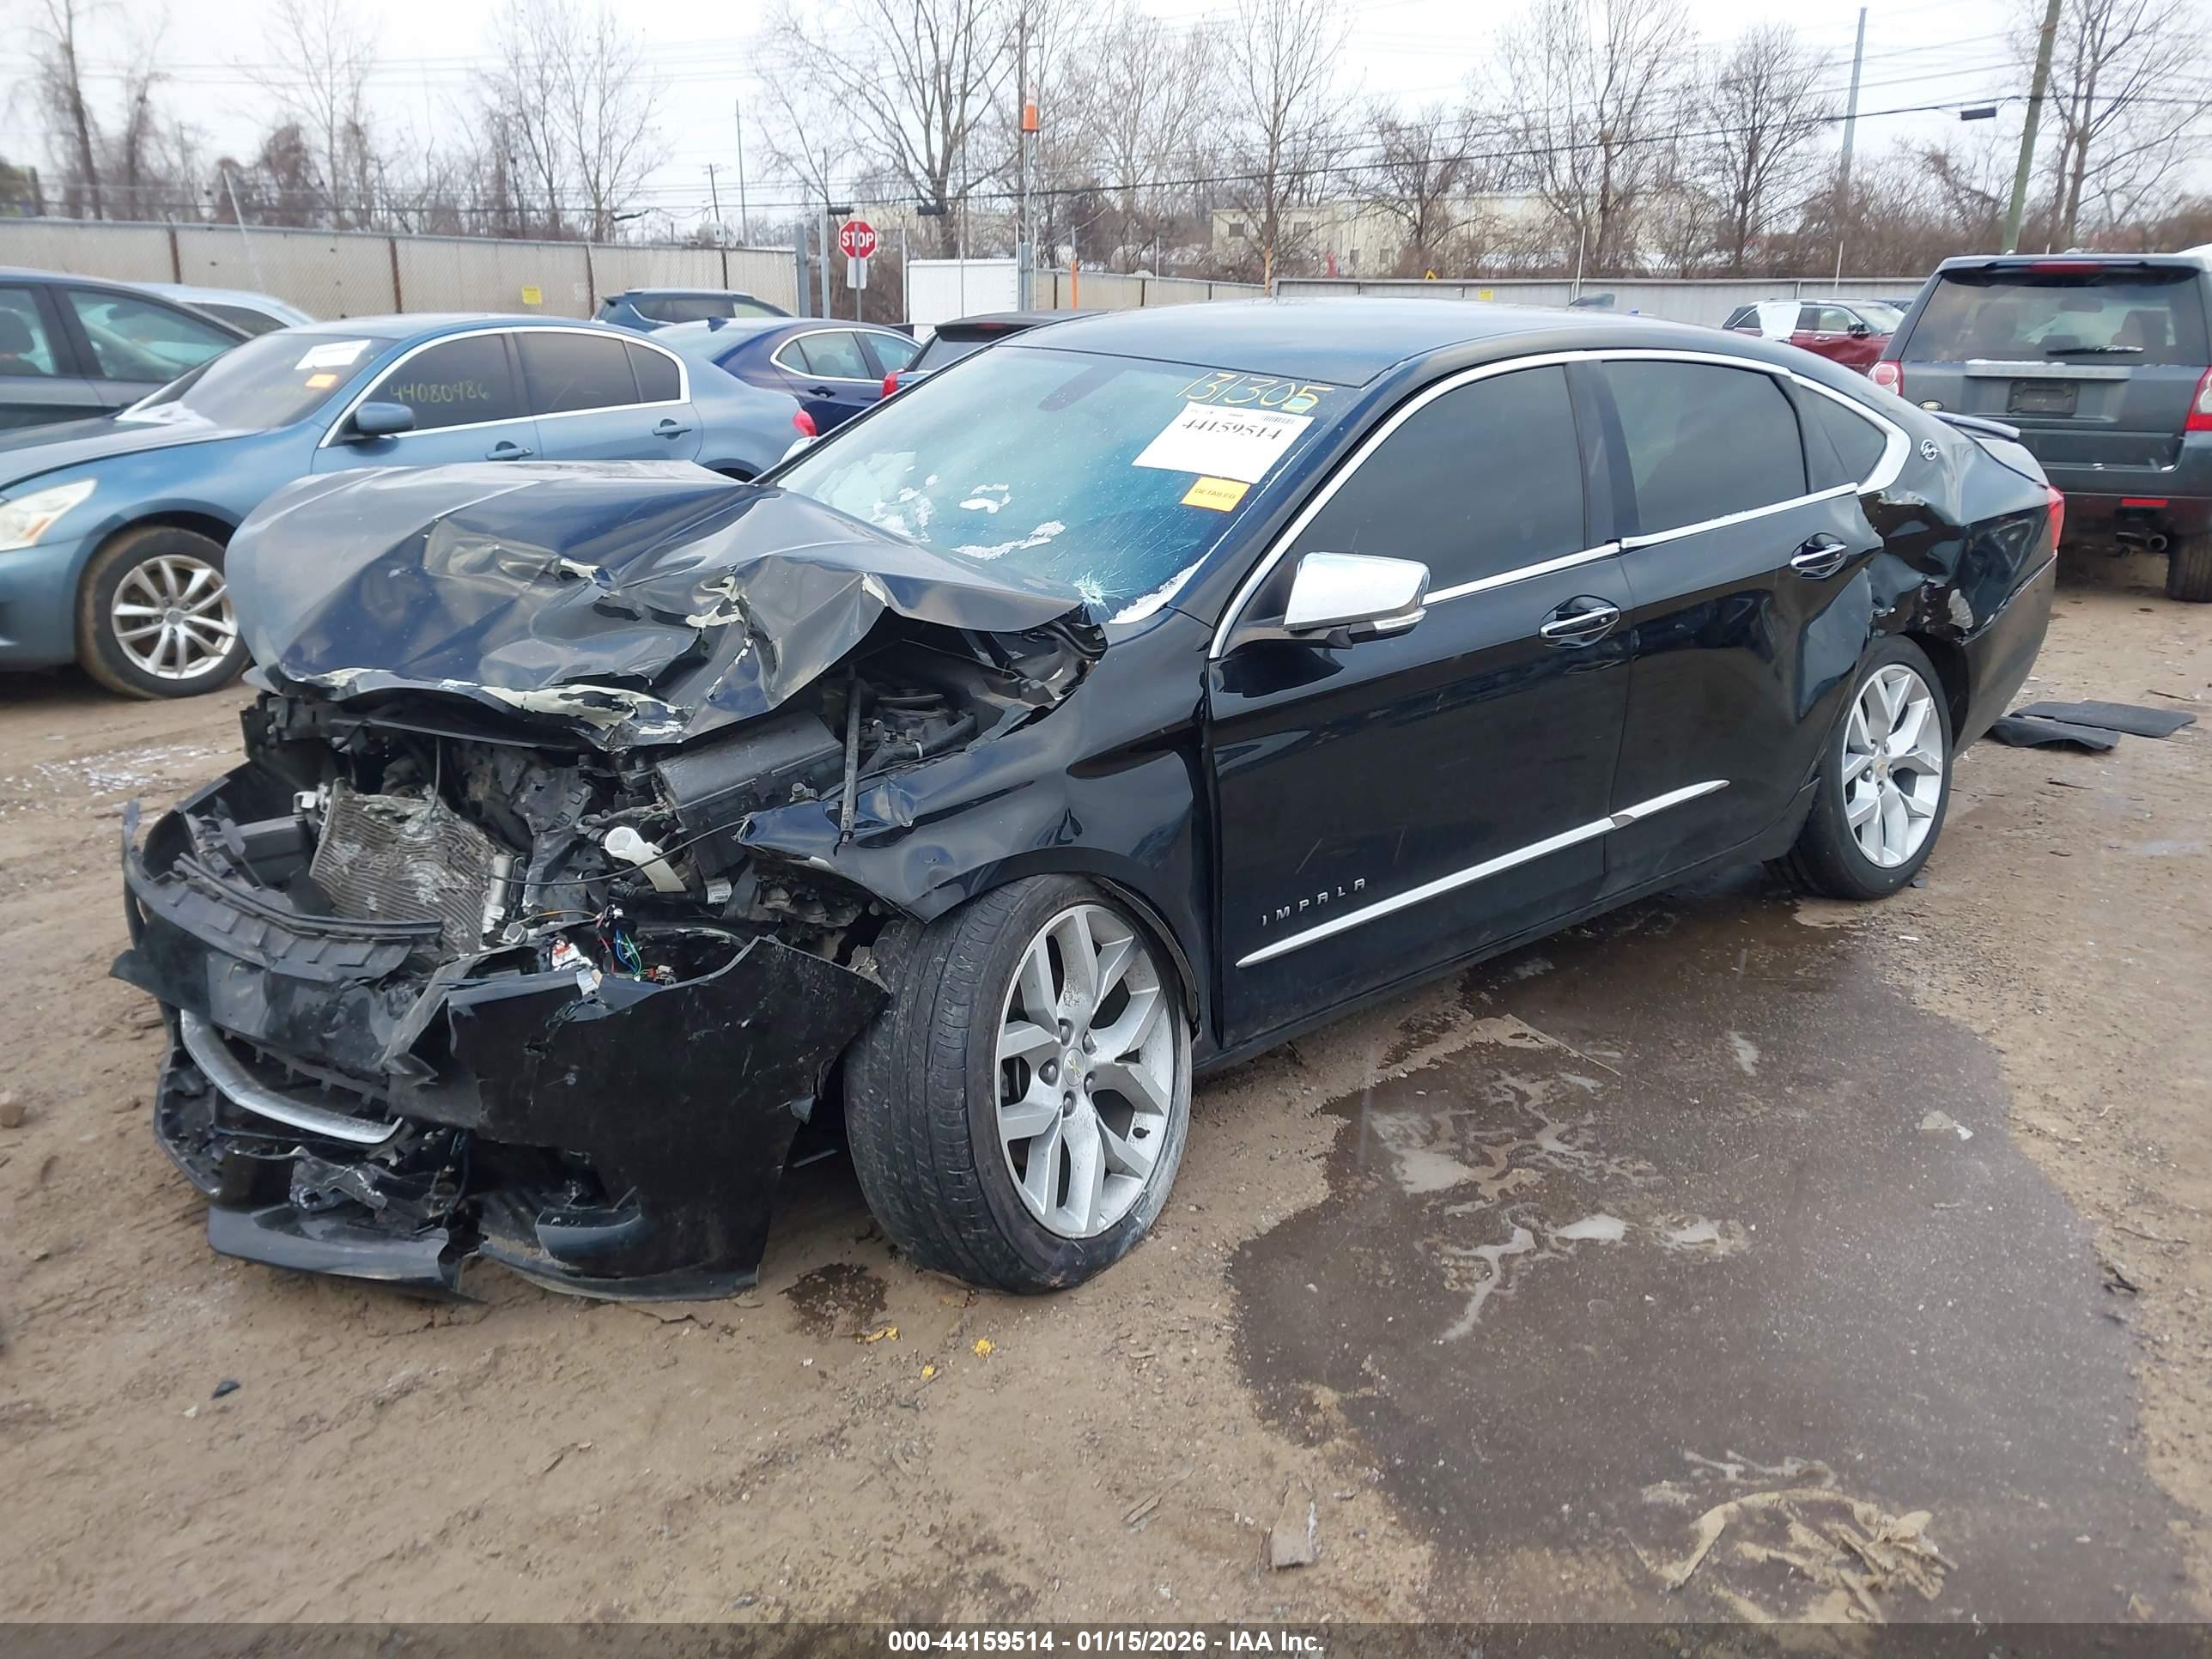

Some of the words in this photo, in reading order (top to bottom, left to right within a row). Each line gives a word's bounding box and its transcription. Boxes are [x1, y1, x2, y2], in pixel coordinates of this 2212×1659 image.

[842, 230, 874, 248] STOP
[1182, 419, 1282, 440] 44159514
[1262, 878, 1365, 927] IMPALA
